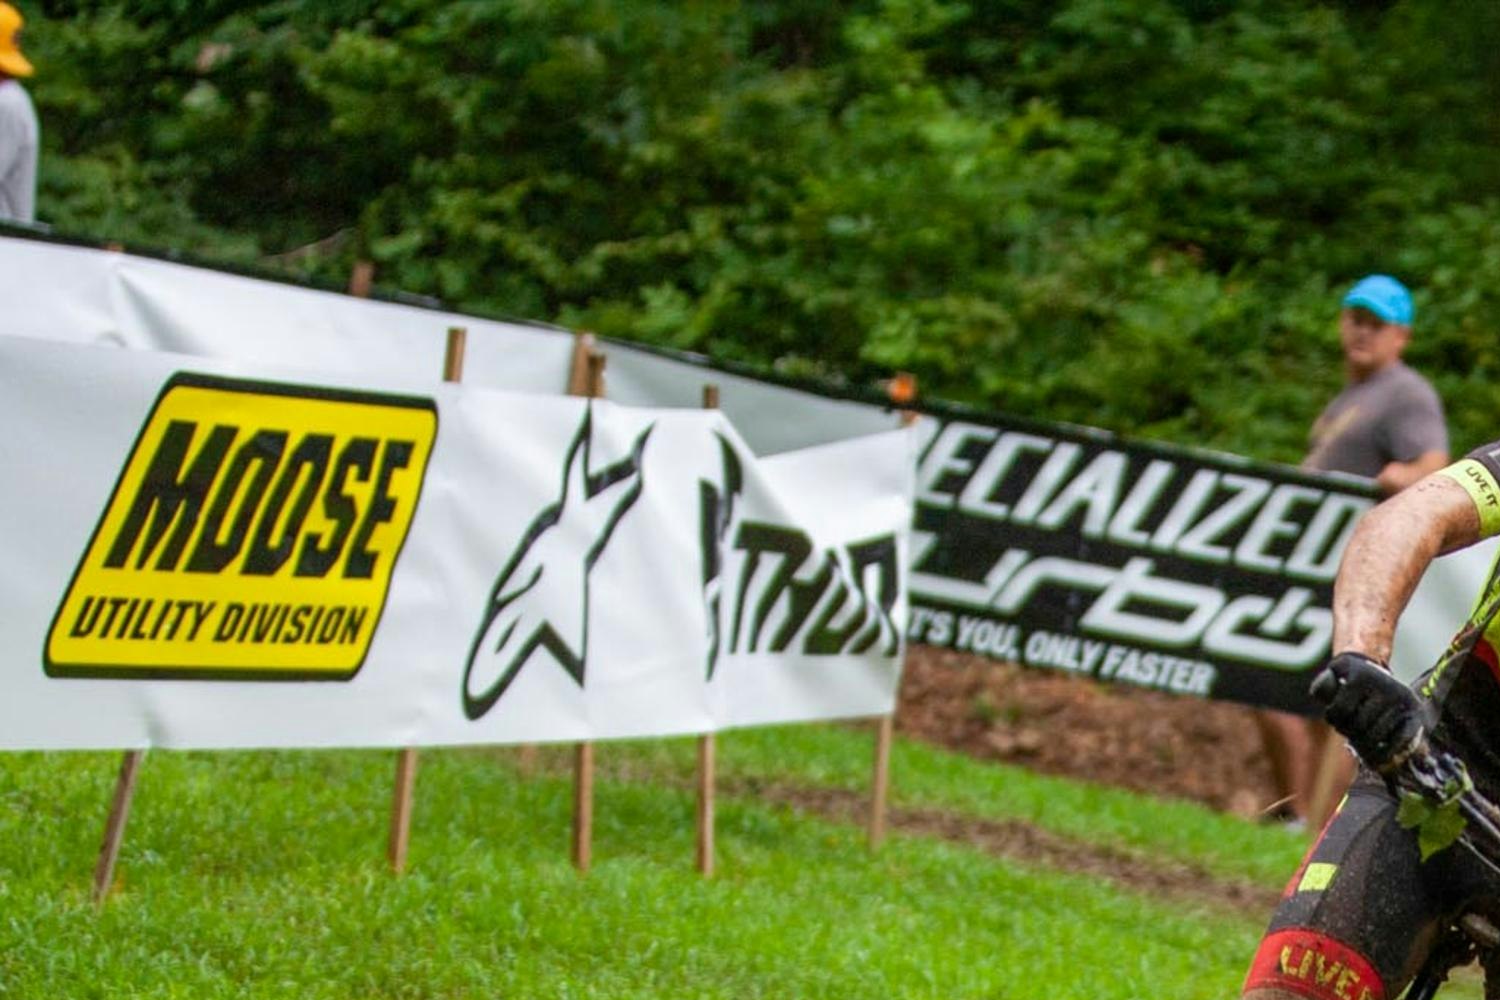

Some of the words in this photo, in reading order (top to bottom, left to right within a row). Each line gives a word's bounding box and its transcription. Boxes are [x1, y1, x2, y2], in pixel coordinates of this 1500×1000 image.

[104, 420, 414, 579] MOOSE
[912, 415, 1378, 582] ECIALIZED
[1465, 466, 1489, 493] LIVE
[70, 597, 207, 641] UTILITY
[213, 602, 369, 646] DIVISION
[1024, 629, 1103, 675] ONLY
[1100, 643, 1217, 696] FASTER
